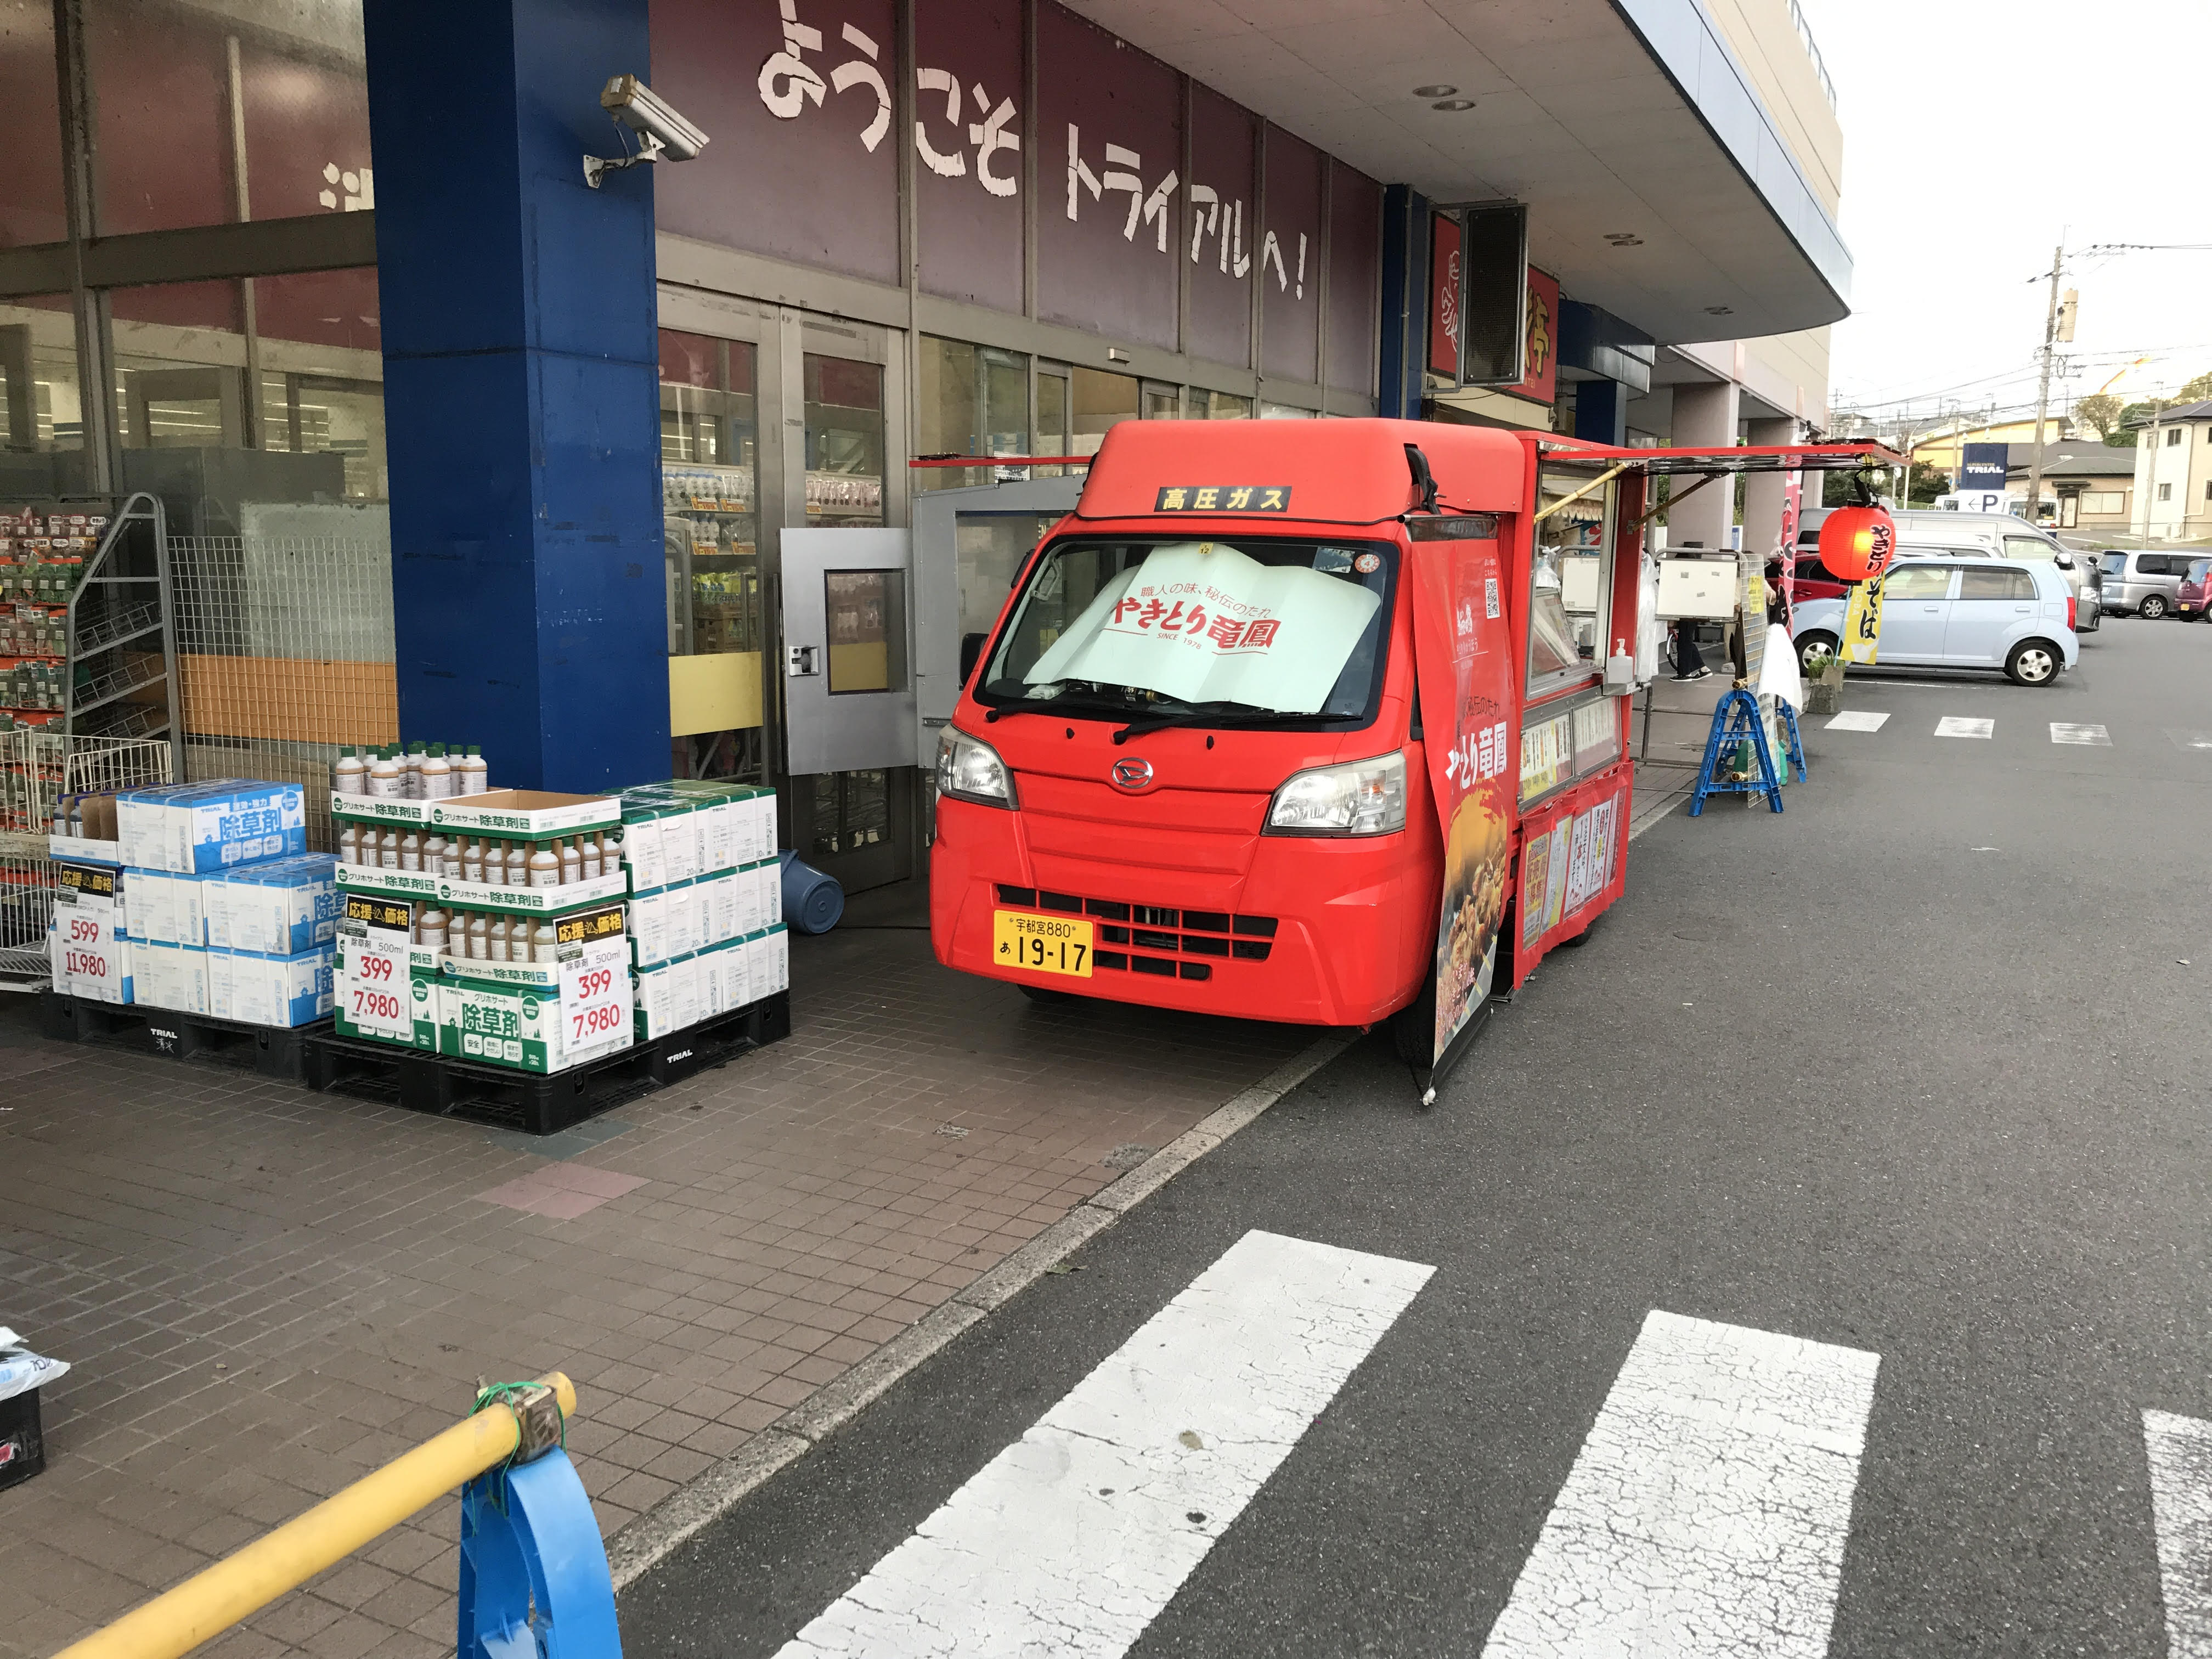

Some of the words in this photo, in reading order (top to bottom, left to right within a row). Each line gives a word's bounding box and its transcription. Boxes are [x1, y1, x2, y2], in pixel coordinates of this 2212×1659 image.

[758, 0, 1019, 197] ようこそ
[1163, 488, 1283, 510] 高圧ガス
[1982, 495, 1998, 512] P
[1867, 524, 1891, 572] やきとり
[1141, 582, 1272, 618] 職人の味、秘伝のたれ
[1156, 632, 1178, 641] SINCE
[1183, 637, 1202, 650] 1978
[1445, 721, 1507, 789] やとり竜鳳
[343, 802, 375, 812] グリホサート
[375, 804, 411, 817] 除草剤
[219, 807, 282, 840] 除草剤
[444, 814, 479, 823] グリホサート
[479, 815, 518, 828] 除草剤
[62, 870, 82, 887] 応援
[92, 874, 112, 892] 価格
[349, 873, 384, 883] グリホサート
[385, 876, 424, 890] 除草剤
[452, 889, 489, 900] グリホサート
[490, 891, 531, 906] 除草剤
[349, 901, 373, 921] 応援
[385, 907, 408, 926] 価格
[71, 919, 99, 943] 599
[558, 921, 585, 943] 応援
[597, 913, 622, 934] 価格
[351, 938, 371, 949] 除草剤
[379, 943, 403, 954] 500ml
[1000, 941, 1011, 955] あ
[1019, 936, 1086, 971] 19-17
[66, 951, 106, 978] 11,980
[297, 958, 317, 967] TRIAL
[360, 956, 393, 981] 399
[566, 958, 589, 972] 除草剤
[596, 950, 620, 964] 500ml
[456, 966, 493, 976] グリホサート
[493, 968, 535, 982] 除草剤
[578, 969, 612, 999] 399
[652, 969, 668, 978] TRIAL
[354, 990, 399, 1019] 7,980
[475, 994, 508, 1006] グリホサート
[462, 1002, 520, 1037] 除草剤
[573, 1004, 620, 1039] 7,980
[150, 1028, 177, 1039] TRIAL
[667, 1049, 692, 1064] TRIAL
